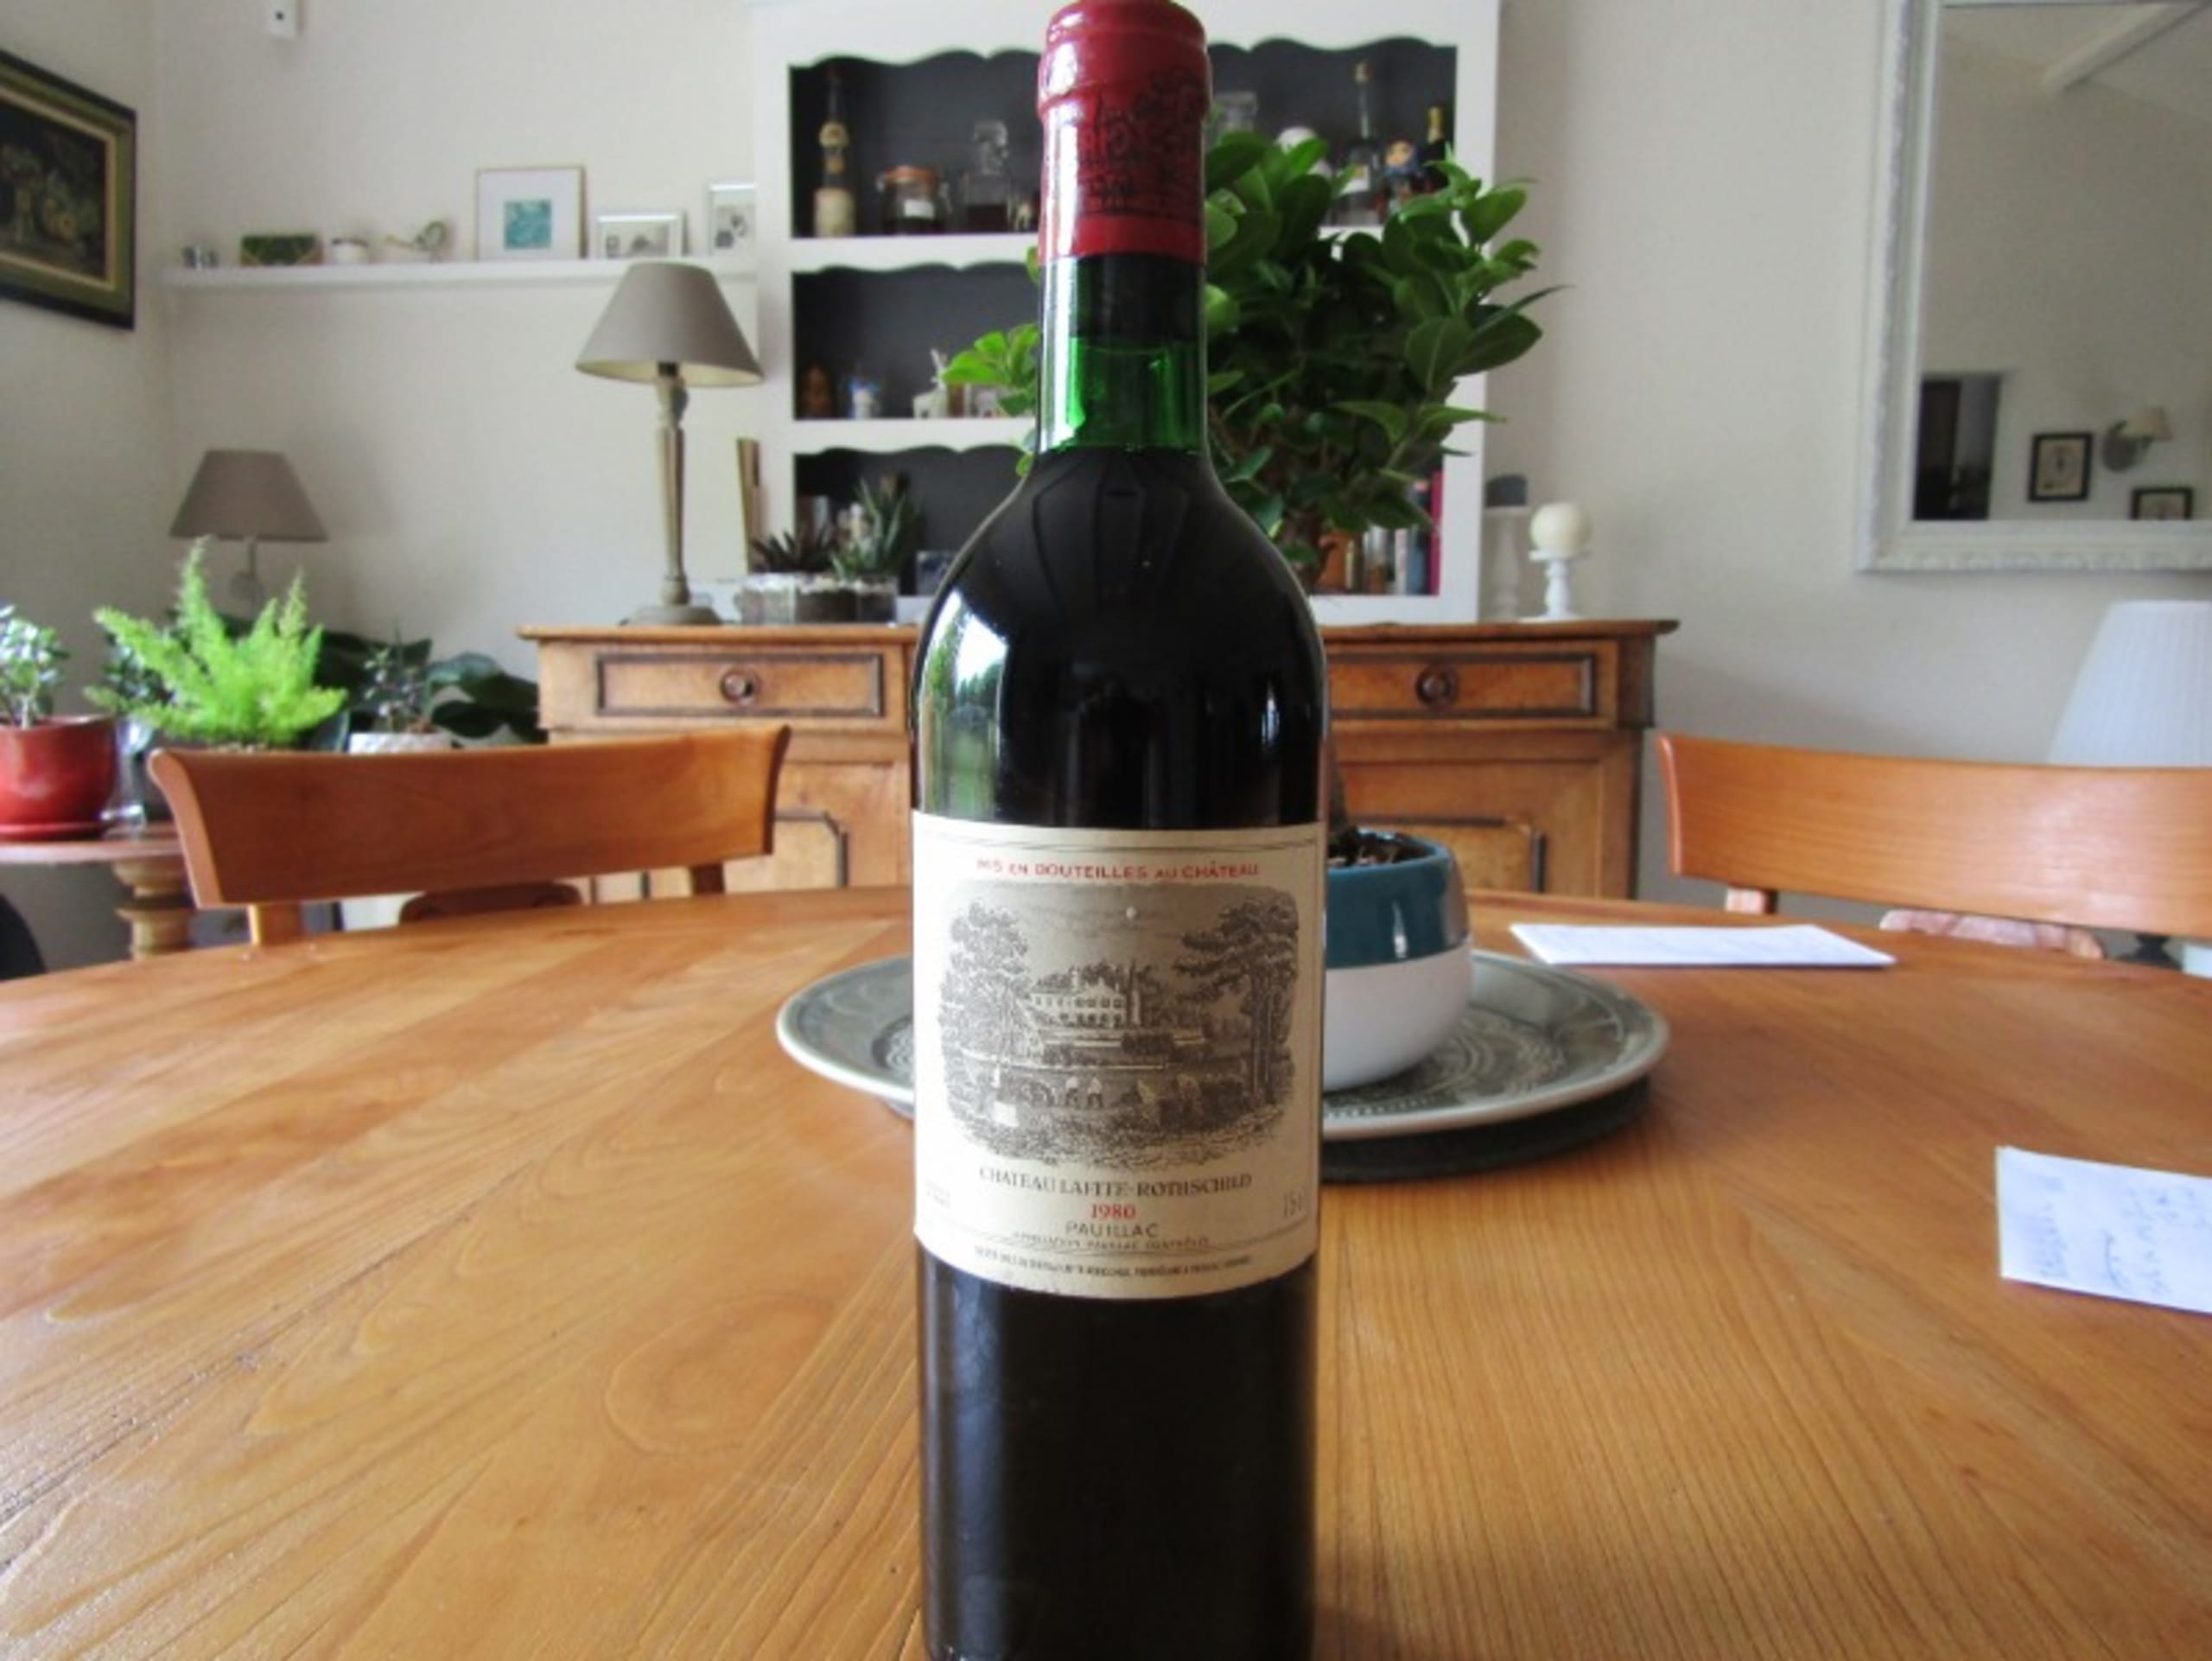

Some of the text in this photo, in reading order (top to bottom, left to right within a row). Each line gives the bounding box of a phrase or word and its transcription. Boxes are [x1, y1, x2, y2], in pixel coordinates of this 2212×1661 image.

[1034, 862, 1148, 880] BOUTEILLES
[1154, 867, 1178, 879] AU
[1091, 1203, 1137, 1219] 1980
[1065, 1220, 1160, 1238] PAUILLAC
